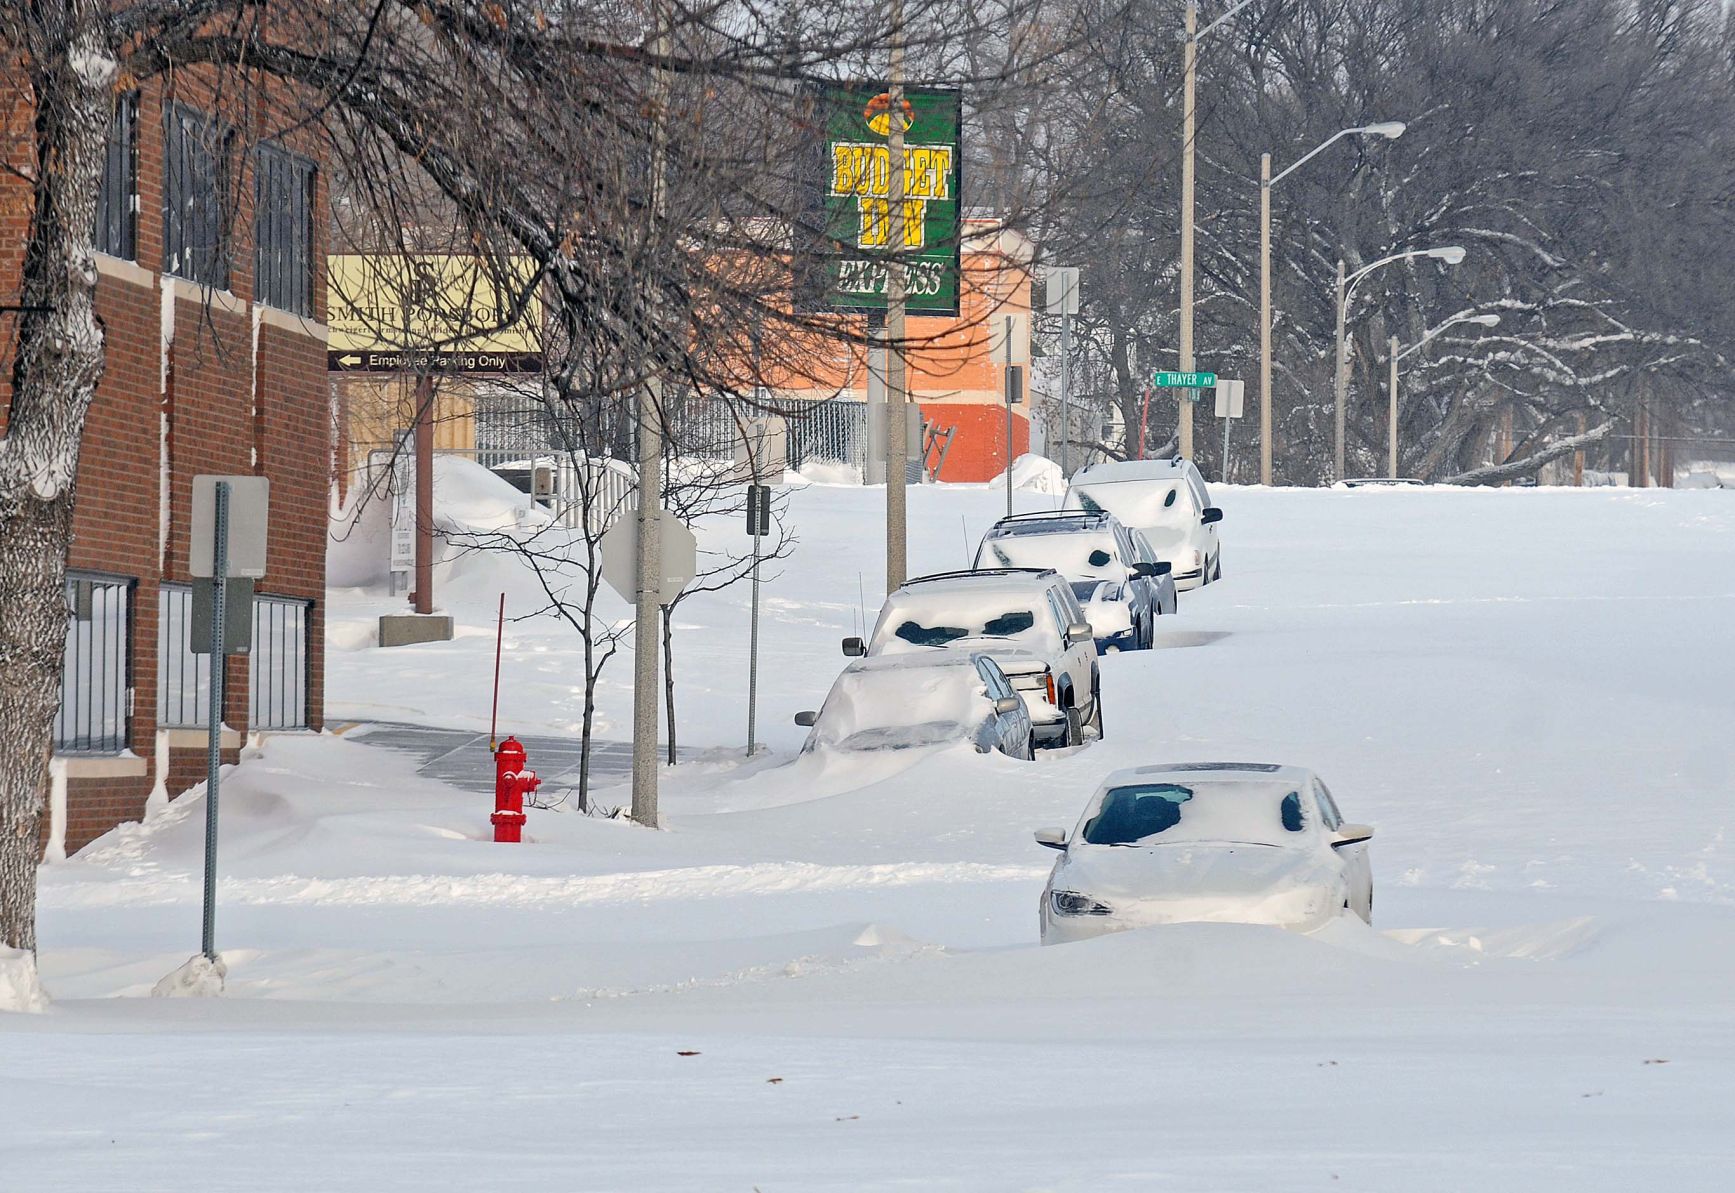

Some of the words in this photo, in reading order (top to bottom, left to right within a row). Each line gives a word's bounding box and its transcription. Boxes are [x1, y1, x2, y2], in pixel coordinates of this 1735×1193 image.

[836, 260, 944, 296] EXPESS
[327, 306, 396, 322] SMITH
[478, 355, 506, 368] Only
[1156, 376, 1161, 385] E
[1167, 373, 1197, 385] THAYER
[1203, 377, 1212, 385] AV
